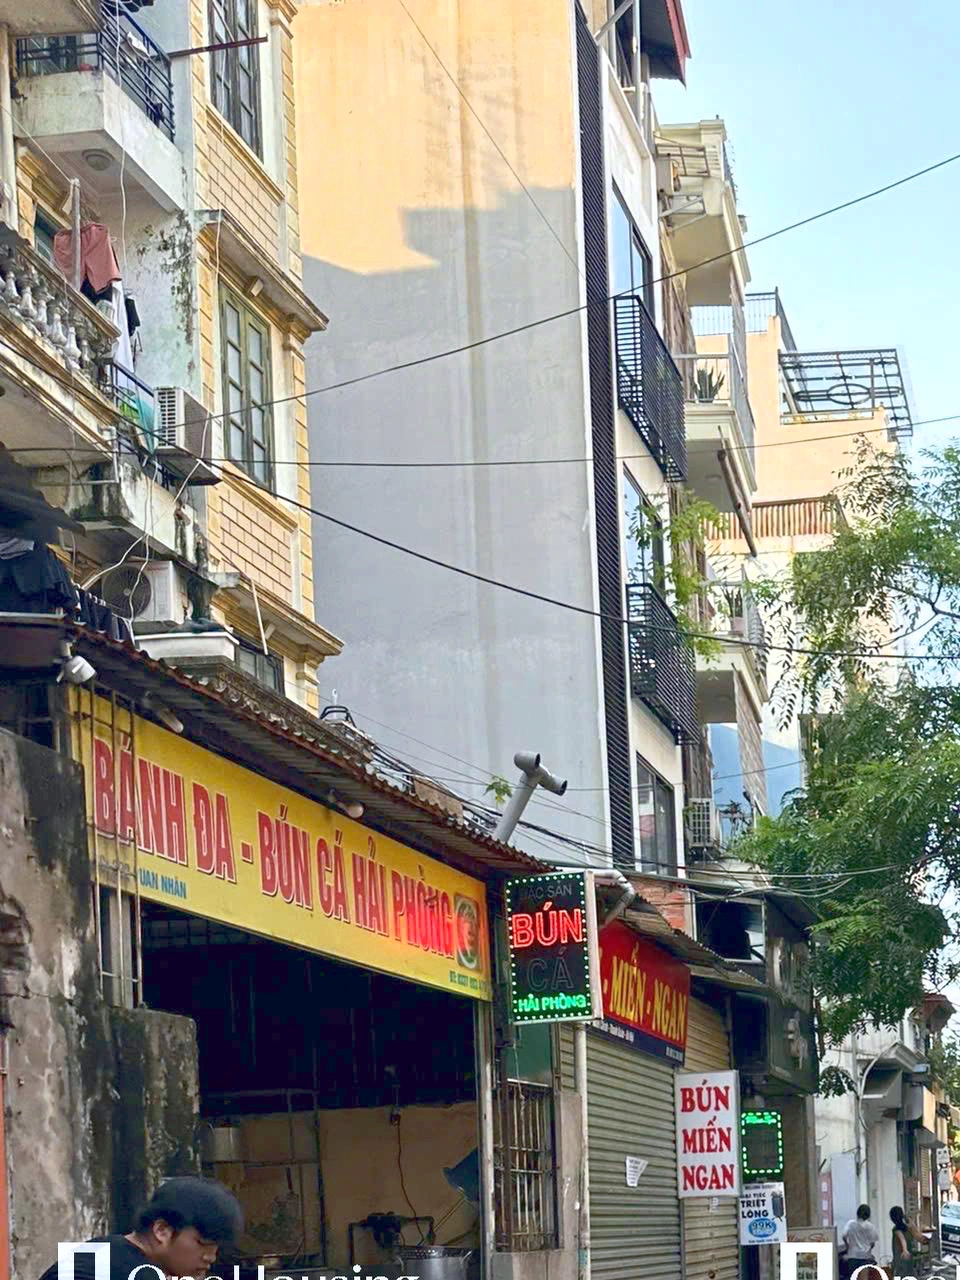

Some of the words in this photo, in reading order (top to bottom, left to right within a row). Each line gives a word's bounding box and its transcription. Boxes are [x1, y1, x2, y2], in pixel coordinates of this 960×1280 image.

[93, 733, 188, 867] BÁNH
[192, 779, 237, 884] ĐA
[256, 801, 313, 911] BÚN
[316, 829, 350, 925] CÁ
[352, 835, 389, 937] HẢI
[391, 864, 455, 959] PHÒNG
[139, 868, 158, 890] UAN
[512, 901, 583, 948] BÚN
[527, 946, 575, 992] CÁ
[518, 993, 540, 1012] HẢI
[541, 992, 587, 1011] PHÒNG
[609, 941, 647, 1026] MIẾN
[652, 977, 687, 1044] NGAN
[680, 1079, 731, 1114] BÚN
[682, 1115, 732, 1154] MIẾN
[681, 1164, 735, 1191] NGAN
